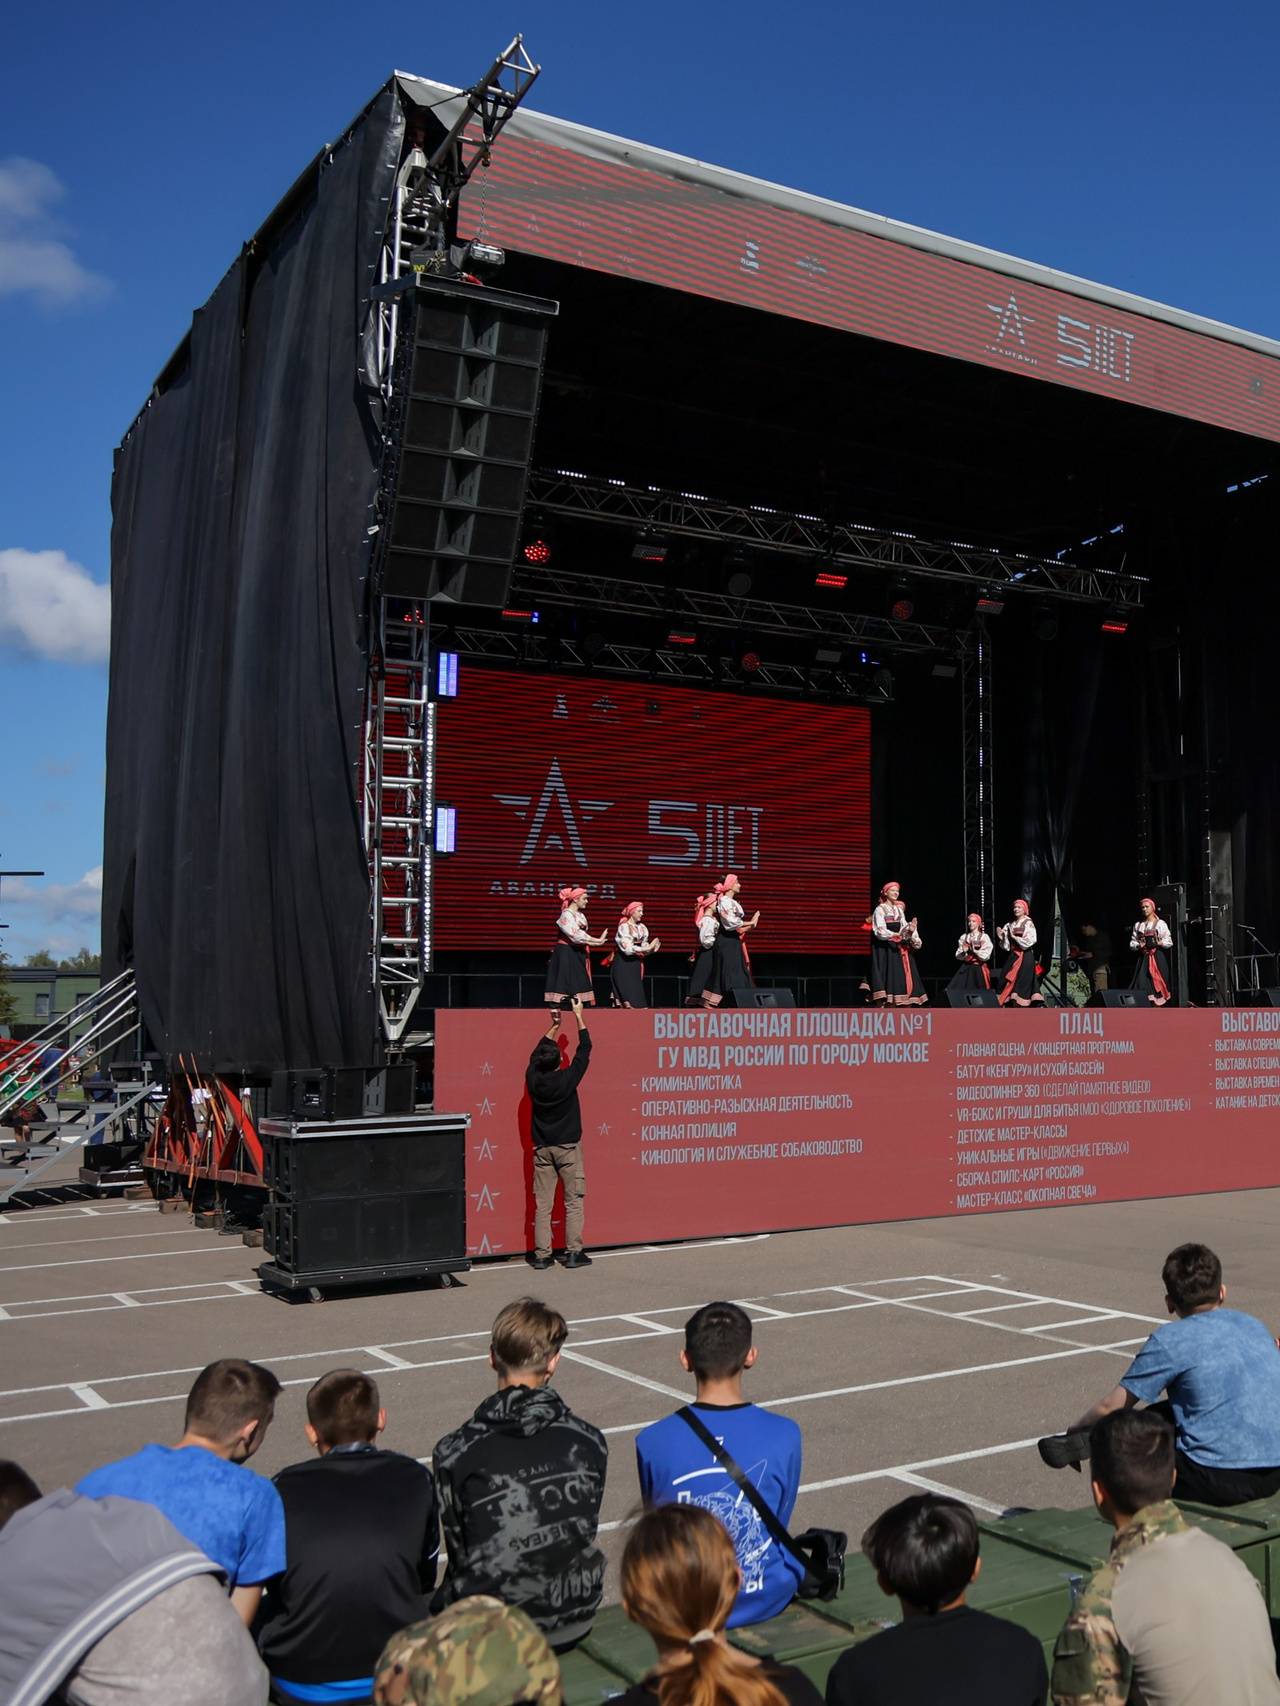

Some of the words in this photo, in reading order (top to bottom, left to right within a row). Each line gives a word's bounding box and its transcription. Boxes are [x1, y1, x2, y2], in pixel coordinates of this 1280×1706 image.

[648, 799, 701, 866] 5
[702, 804, 764, 870] ЛЕТ
[654, 1012, 791, 1039] ВЫСТАВОЧНАЯ
[796, 1012, 895, 1039] ПЛОЩАДКА
[900, 1012, 933, 1036] №1
[1060, 1013, 1104, 1036] ПЛАЦ
[957, 1043, 996, 1057] ГЛАВНАЯ
[998, 1043, 1025, 1057] СЦЕНА
[1034, 1042, 1085, 1055] КОНЦЕРТНАЯ
[1088, 1041, 1134, 1054] ПРОГРАММА
[1215, 1039, 1252, 1051] ВЫСТАВКА
[658, 1046, 679, 1069] ГУ
[683, 1046, 721, 1070] МВД
[724, 1045, 784, 1067] РОССИИ
[788, 1044, 809, 1065] ПО
[812, 1043, 870, 1067] ГОРОДУ
[873, 1042, 929, 1064] МОСКВЕ
[1215, 1058, 1252, 1070] ВЫСТАВКА
[957, 1065, 984, 1078] БАТУТ
[986, 1064, 1032, 1077] «КЕНГУРУ»
[1033, 1064, 1039, 1076] И
[1040, 1060, 1067, 1076] СУХОЙ
[1069, 1060, 1104, 1075] БАССЕЙН
[642, 1075, 742, 1092] КРИМИНАЛИСТИКА
[957, 1085, 1023, 1101] ВИДЕОСПИННЕР
[1025, 1084, 1039, 1097] 360
[1043, 1083, 1078, 1097] (СДЕЛАЙ
[1080, 1081, 1120, 1095] ПАМЯТНОЕ
[1216, 1077, 1252, 1090] ВЫСТАВКА
[1253, 1076, 1279, 1088] ВРЕМЕН
[642, 1097, 777, 1117] ОПЕРАТИВНО-РАЗЫСКНАЯ
[778, 1094, 853, 1113] ДЕЯТЕЛЬНОСТЬ
[1216, 1096, 1247, 1109] КАТАНИЕ
[1248, 1095, 1257, 1107] НА
[957, 1107, 994, 1122] VR-БОКС
[1003, 1105, 1032, 1119] ГРУШИ
[1034, 1105, 1051, 1119] ДЛЯ
[1053, 1103, 1078, 1116] БИТЬЯ
[642, 1123, 684, 1141] КОННАЯ
[687, 1122, 736, 1139] ПОЛИЦИЯ
[957, 1128, 995, 1144] ДЕТСКИЕ
[998, 1125, 1067, 1141] МАСТЕР-КЛАССЫ
[642, 1146, 705, 1165] КИНОЛОГИЯ
[707, 1146, 714, 1162] И
[716, 1142, 778, 1161] СЛУЖЕБНОЕ
[781, 1138, 863, 1158] СОБАКОВОДСТВО
[957, 1149, 1014, 1165] УНИКАЛЬНЫЕ
[1017, 1147, 1039, 1161] ИГРЫ
[957, 1171, 991, 1187] СБОРКА
[992, 1168, 1043, 1184] СПИЛС-КАРТ
[1046, 1164, 1084, 1179] «РОССИЯ»
[957, 1190, 1022, 1208] МАСТЕР-КЛАСС
[1024, 1186, 1066, 1202] «ОКОПНАЯ
[1067, 1185, 1096, 1198] СВЕЧА»
